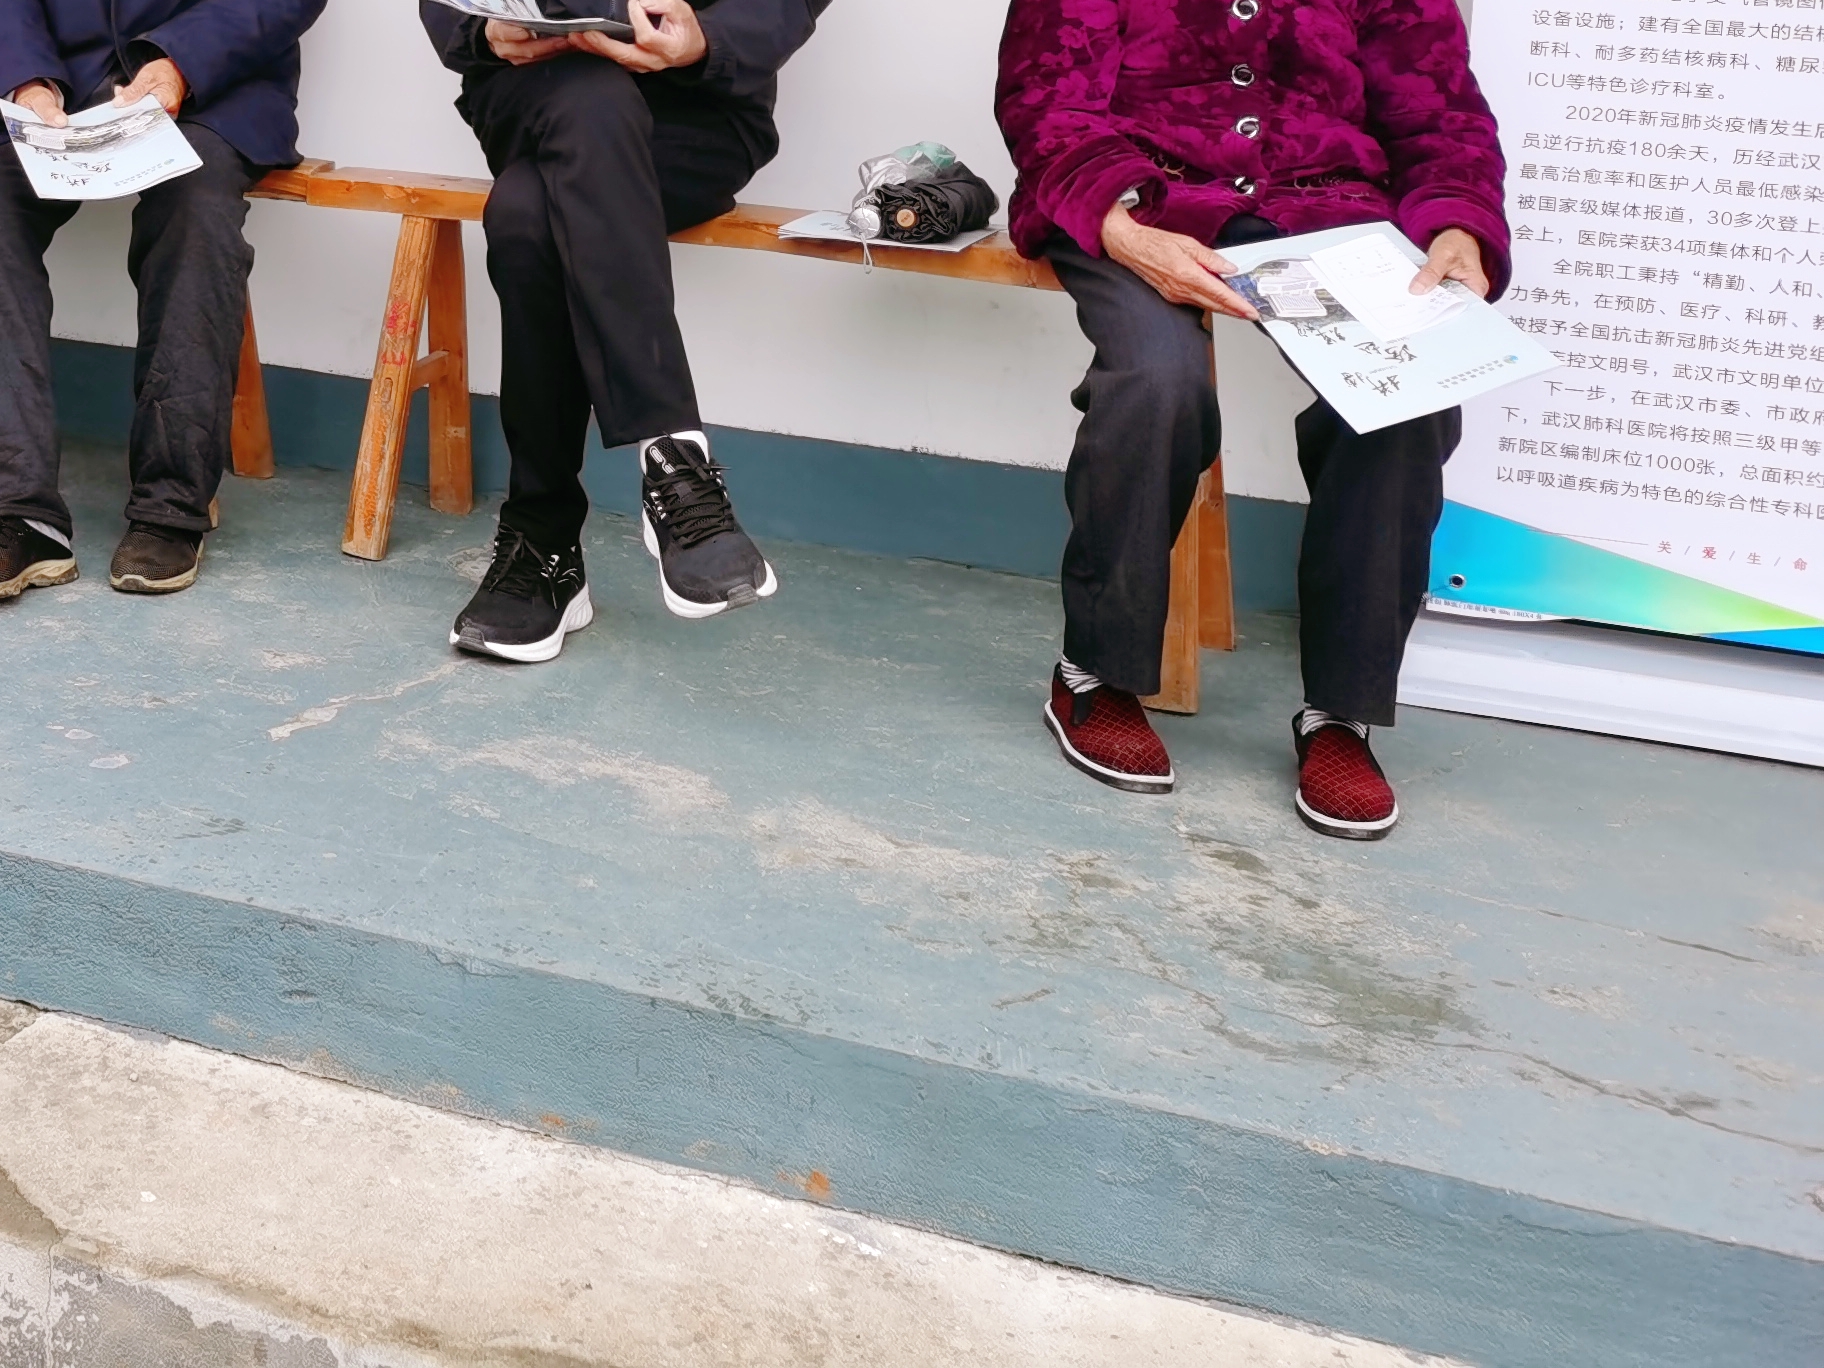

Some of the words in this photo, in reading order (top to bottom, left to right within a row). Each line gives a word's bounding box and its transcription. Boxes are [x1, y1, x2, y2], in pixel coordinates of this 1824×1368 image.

[1530, 41, 1824, 74] 断科、耐多药结核病科、糖尿
[1528, 72, 1724, 99] ICU等特色诊疗科室。
[1517, 194, 1824, 235] 被国家级媒体报道，30多次登上
